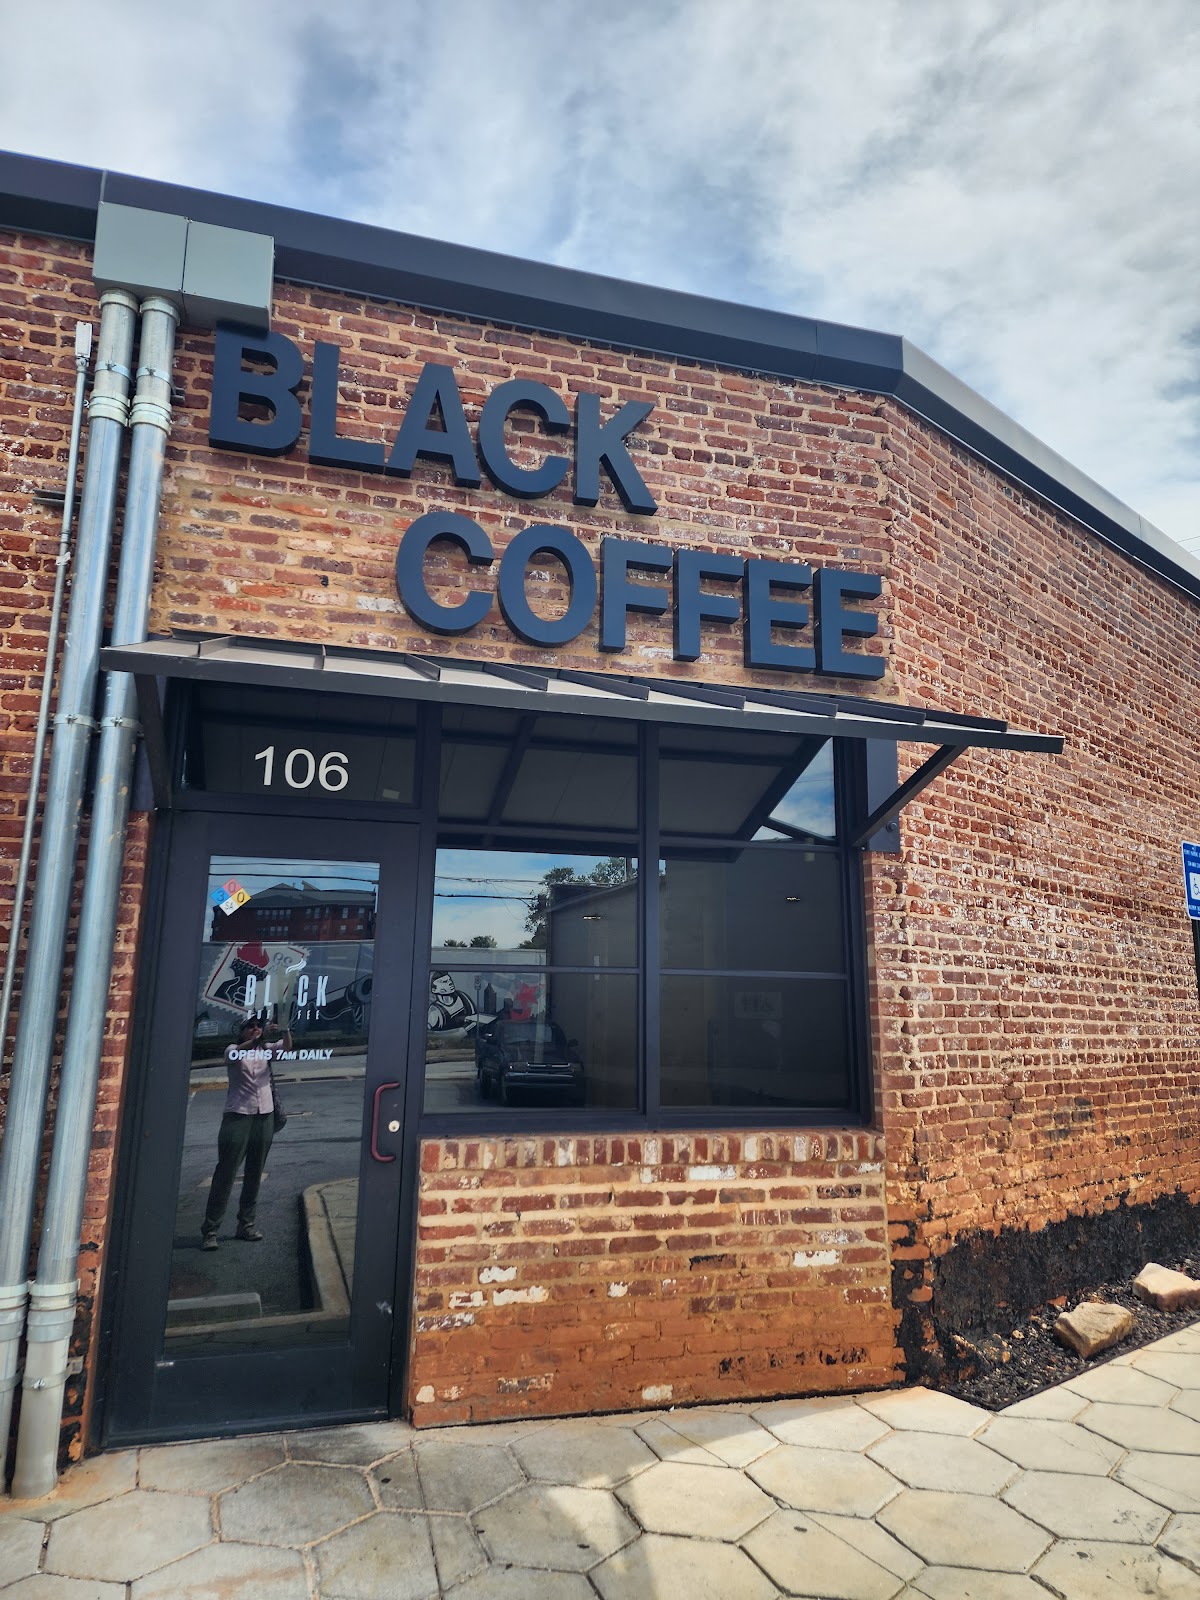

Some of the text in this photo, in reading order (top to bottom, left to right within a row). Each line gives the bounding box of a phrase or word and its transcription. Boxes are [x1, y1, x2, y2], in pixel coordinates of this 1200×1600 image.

[208, 323, 659, 516] BLACK
[396, 510, 886, 680] COFFEE
[255, 745, 349, 792] 106
[216, 890, 225, 902] 3
[237, 891, 245, 904] 0
[228, 1049, 334, 1061] OPENS 7AM DAILY
